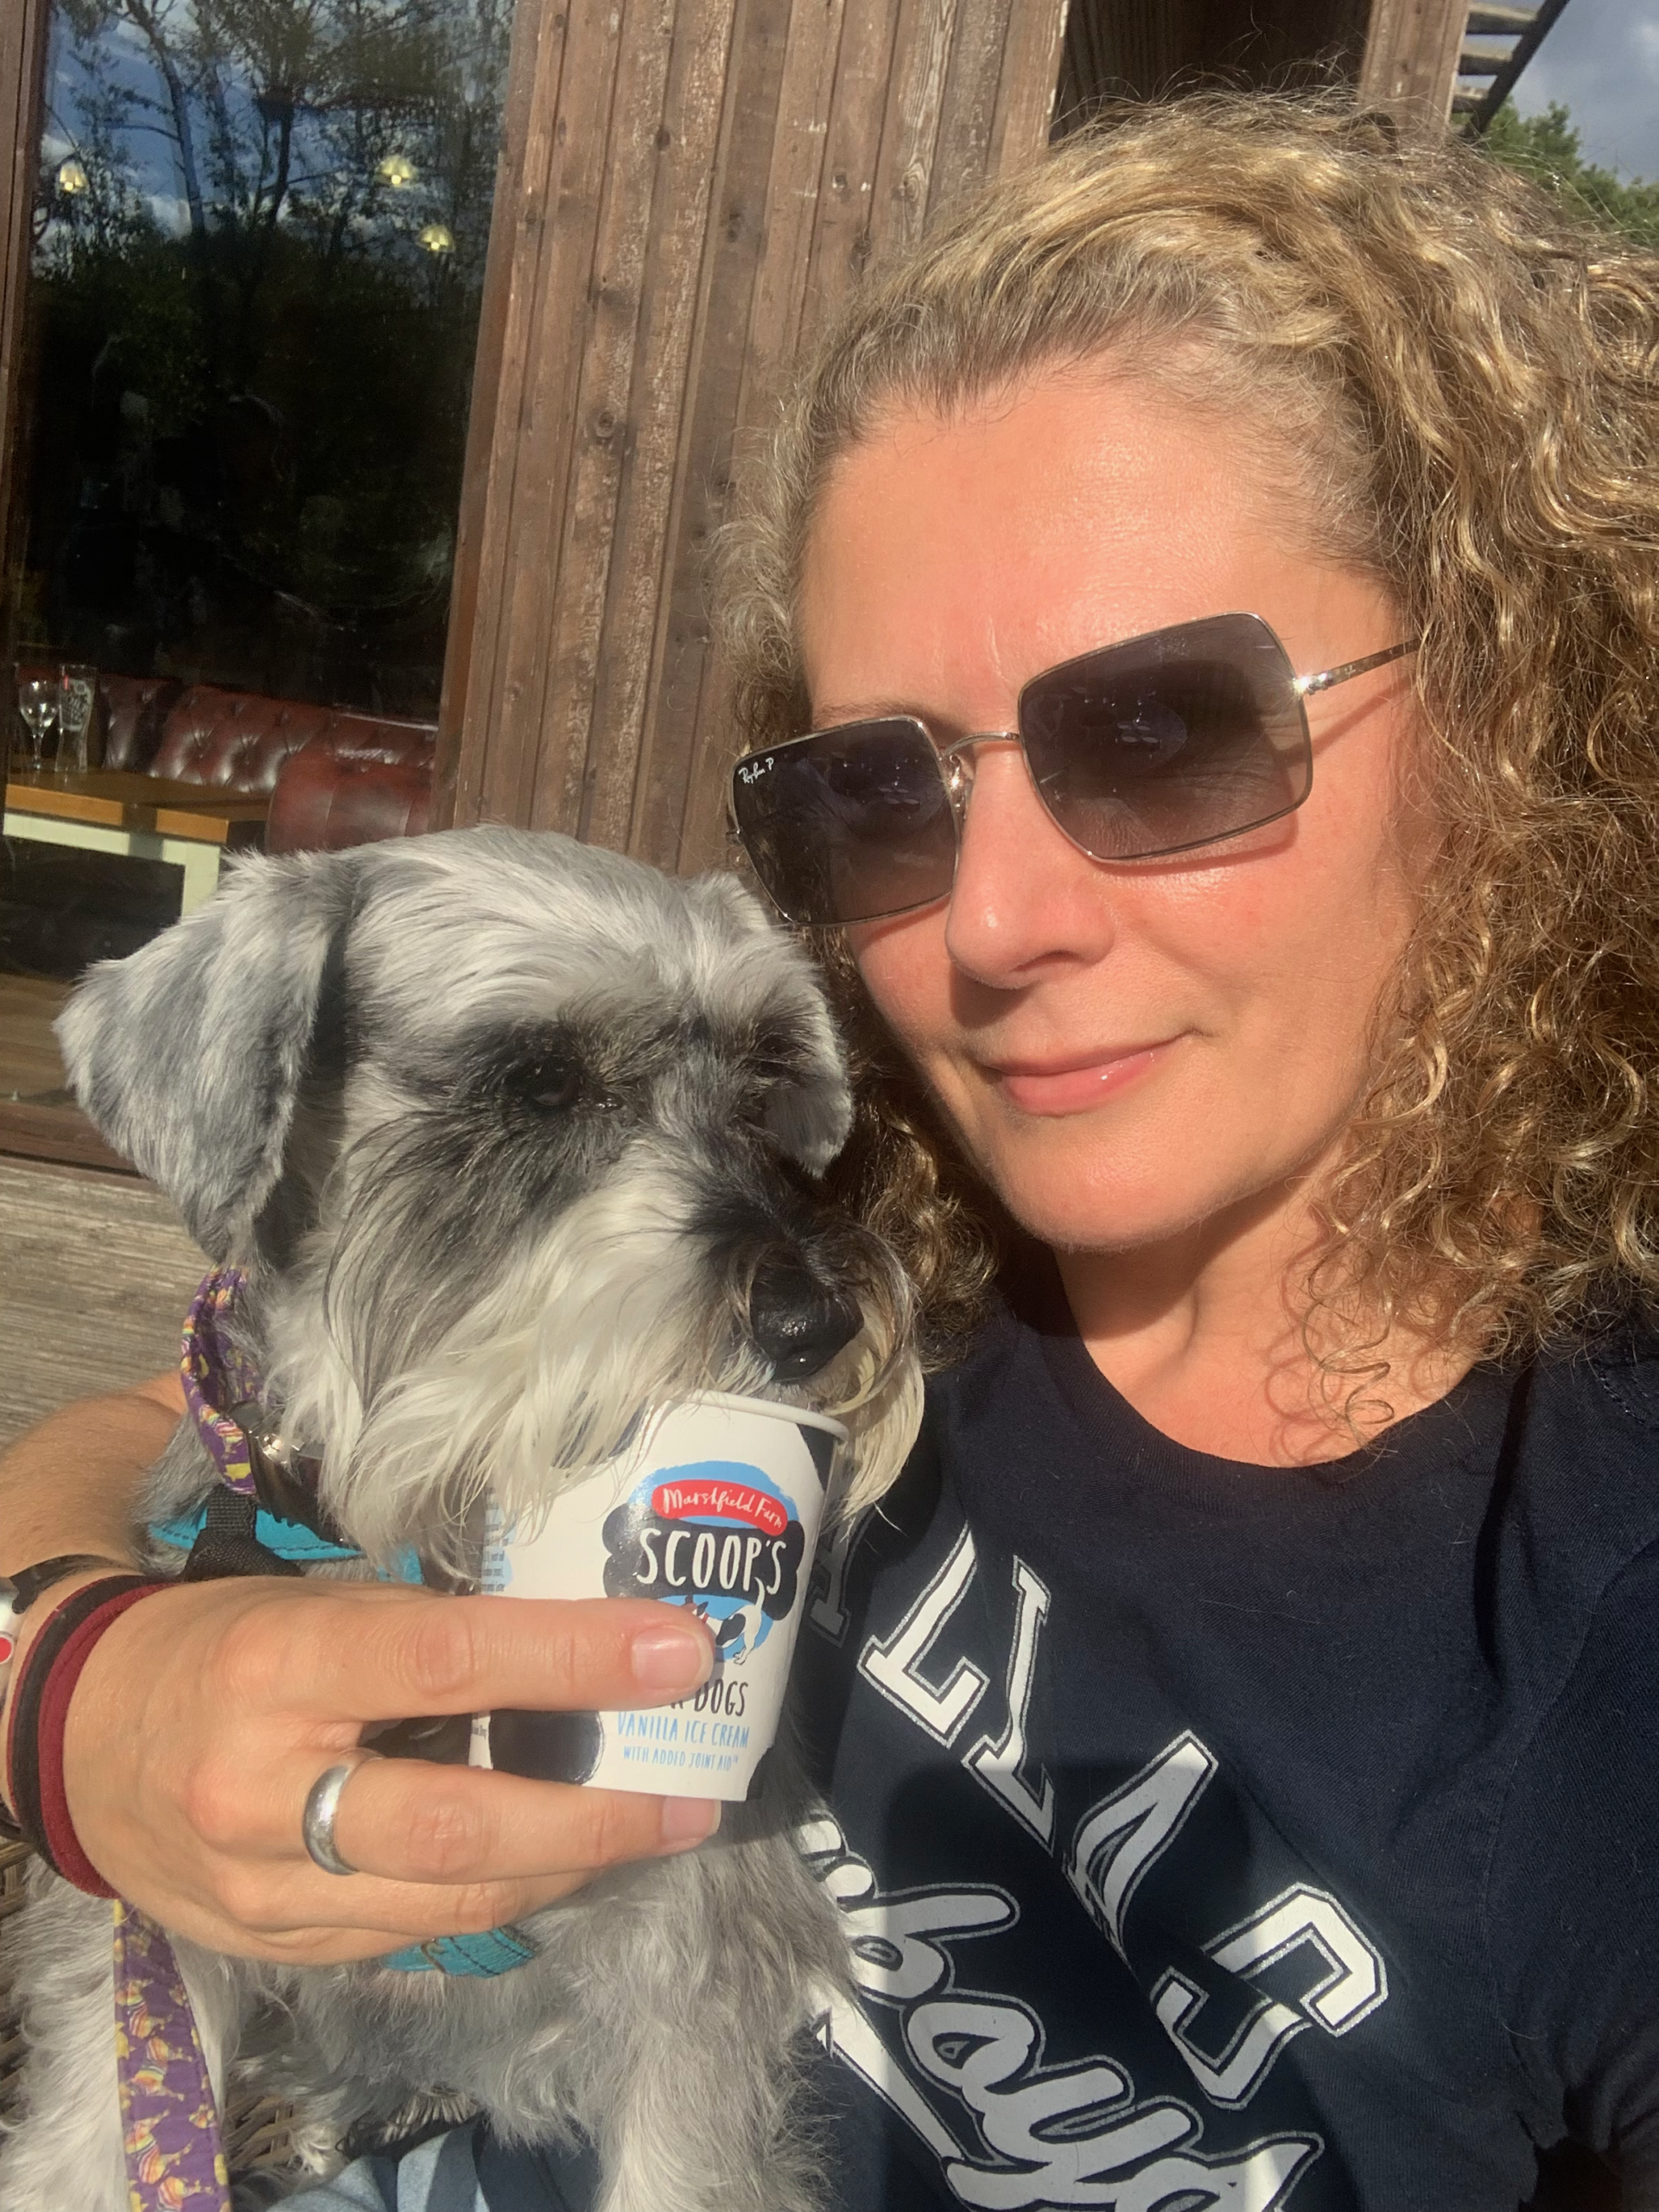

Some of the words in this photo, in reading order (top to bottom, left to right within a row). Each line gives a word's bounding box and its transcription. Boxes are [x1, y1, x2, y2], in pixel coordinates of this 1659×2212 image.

[663, 1487, 753, 1514] Marshfield
[754, 1497, 782, 1528] Farm
[636, 1528, 786, 1595] SCOOP'S
[694, 1678, 748, 1717] DOGS
[618, 1711, 678, 1742] VANILLA
[684, 1719, 708, 1744] ICE
[711, 1722, 750, 1749] CREAM
[624, 1745, 649, 1763] WITH
[652, 1748, 686, 1767] ADDED
[689, 1752, 716, 1770] JOINT
